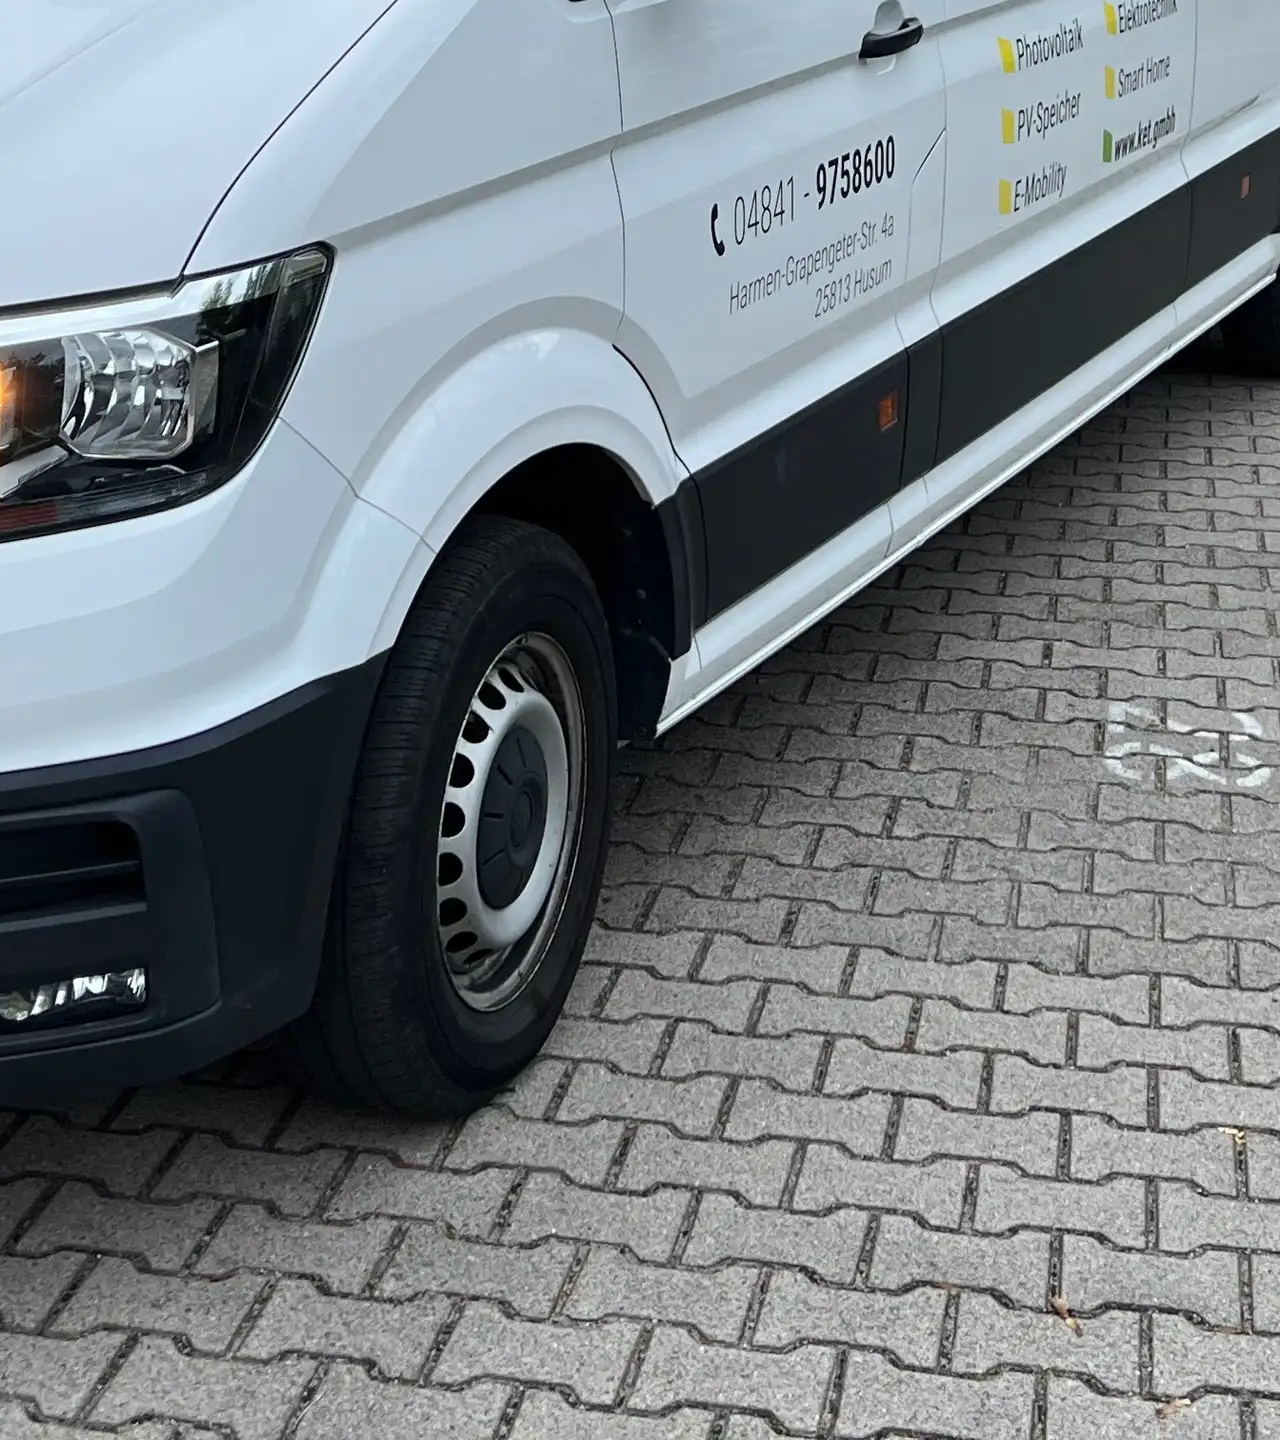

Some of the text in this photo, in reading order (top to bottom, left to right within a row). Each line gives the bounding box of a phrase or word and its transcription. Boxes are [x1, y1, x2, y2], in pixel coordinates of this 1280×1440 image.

[1016, 17, 1084, 71] Photovoltaik
[1117, 56, 1171, 98] Smart Home
[1017, 88, 1081, 141] PV-Speicher
[1114, 105, 1176, 162] www.ket.gmbh
[734, 175, 794, 245] 04841
[816, 135, 895, 210] 9758600
[1013, 160, 1067, 212] E-Mobility
[729, 212, 895, 315] Harmen-Grapengeter-Str. 4a
[814, 259, 892, 318] 25813 Husum
